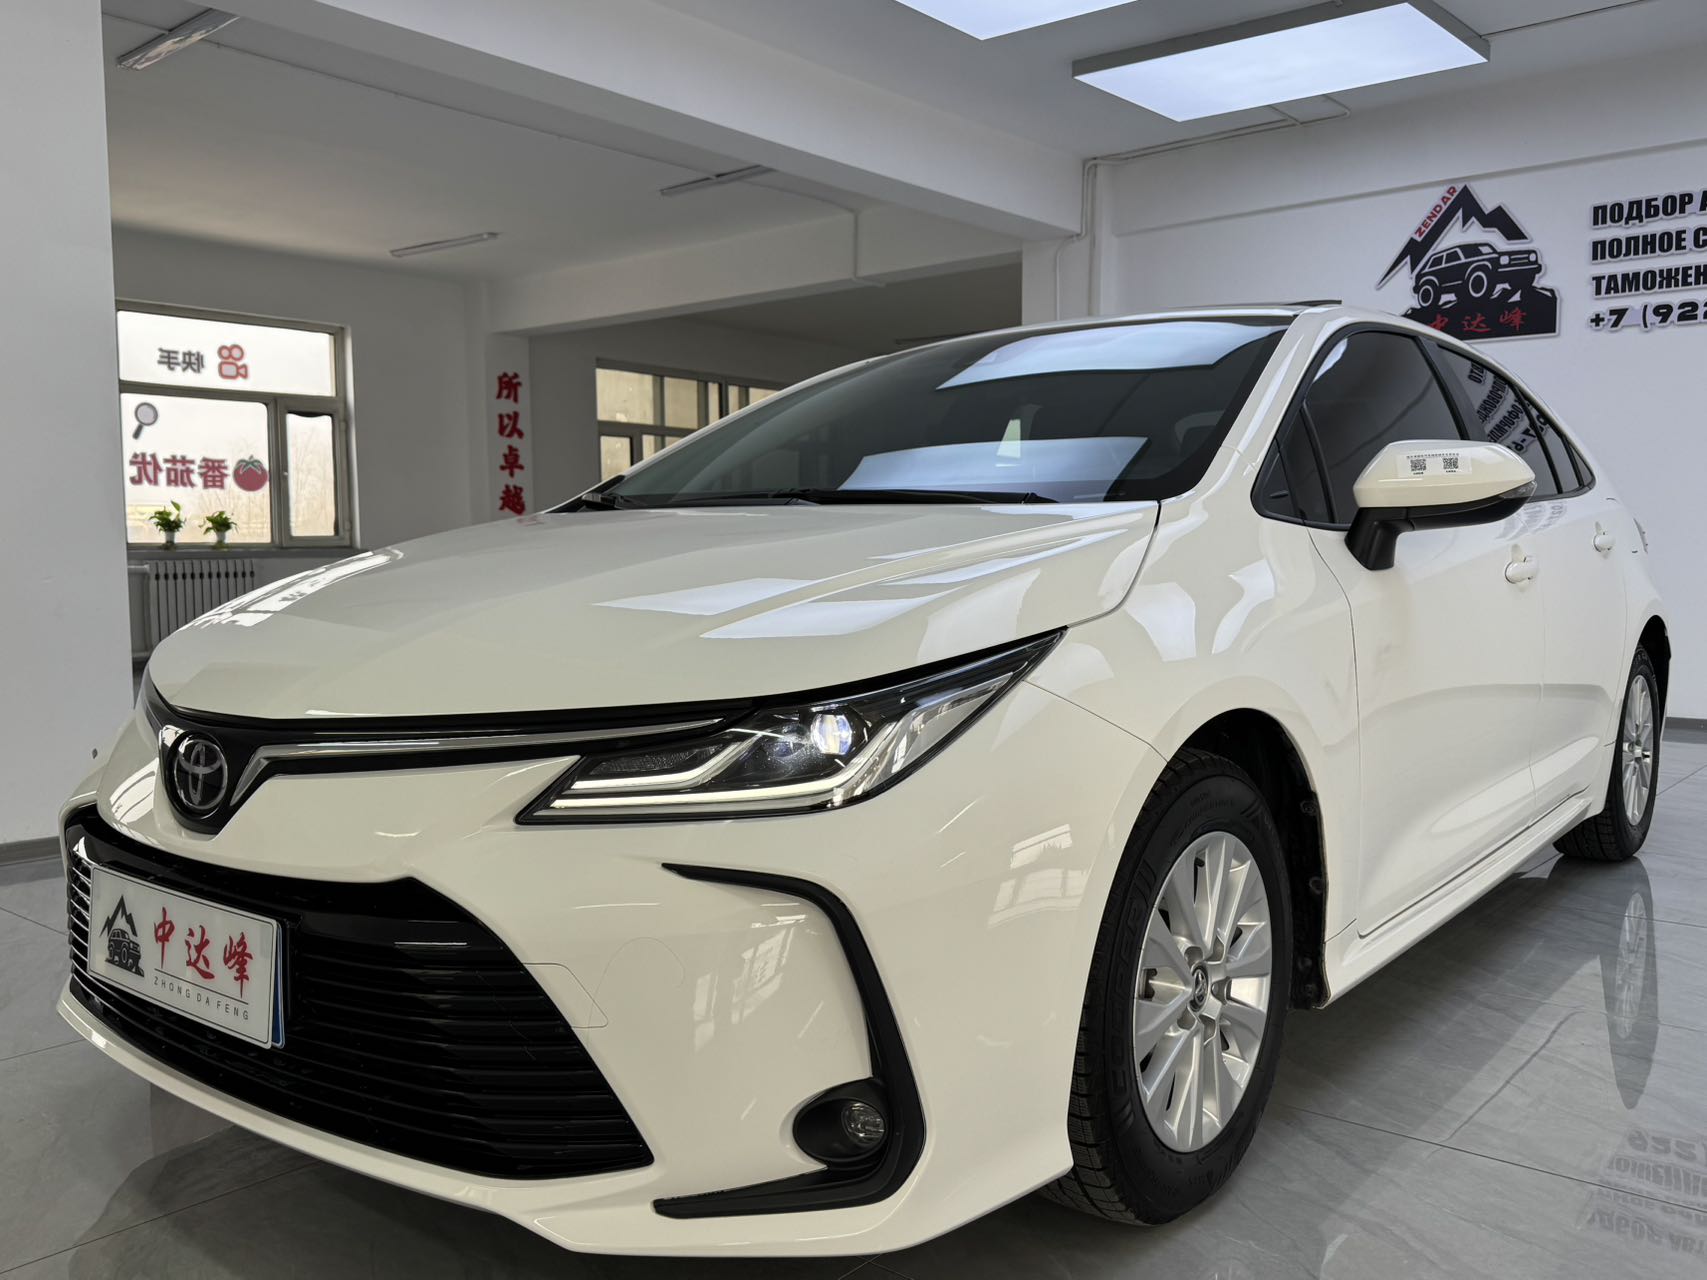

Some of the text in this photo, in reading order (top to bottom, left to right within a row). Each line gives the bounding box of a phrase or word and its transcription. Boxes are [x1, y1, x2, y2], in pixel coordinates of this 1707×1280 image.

[1414, 185, 1458, 238] ZENDAR
[1592, 193, 1694, 226] ПОДБОР
[1592, 229, 1687, 261] ПОЛНОЕ
[1590, 307, 1630, 329] +7
[153, 906, 254, 999] 中达峰
[153, 975, 249, 1021] ZHONG DA FENG
